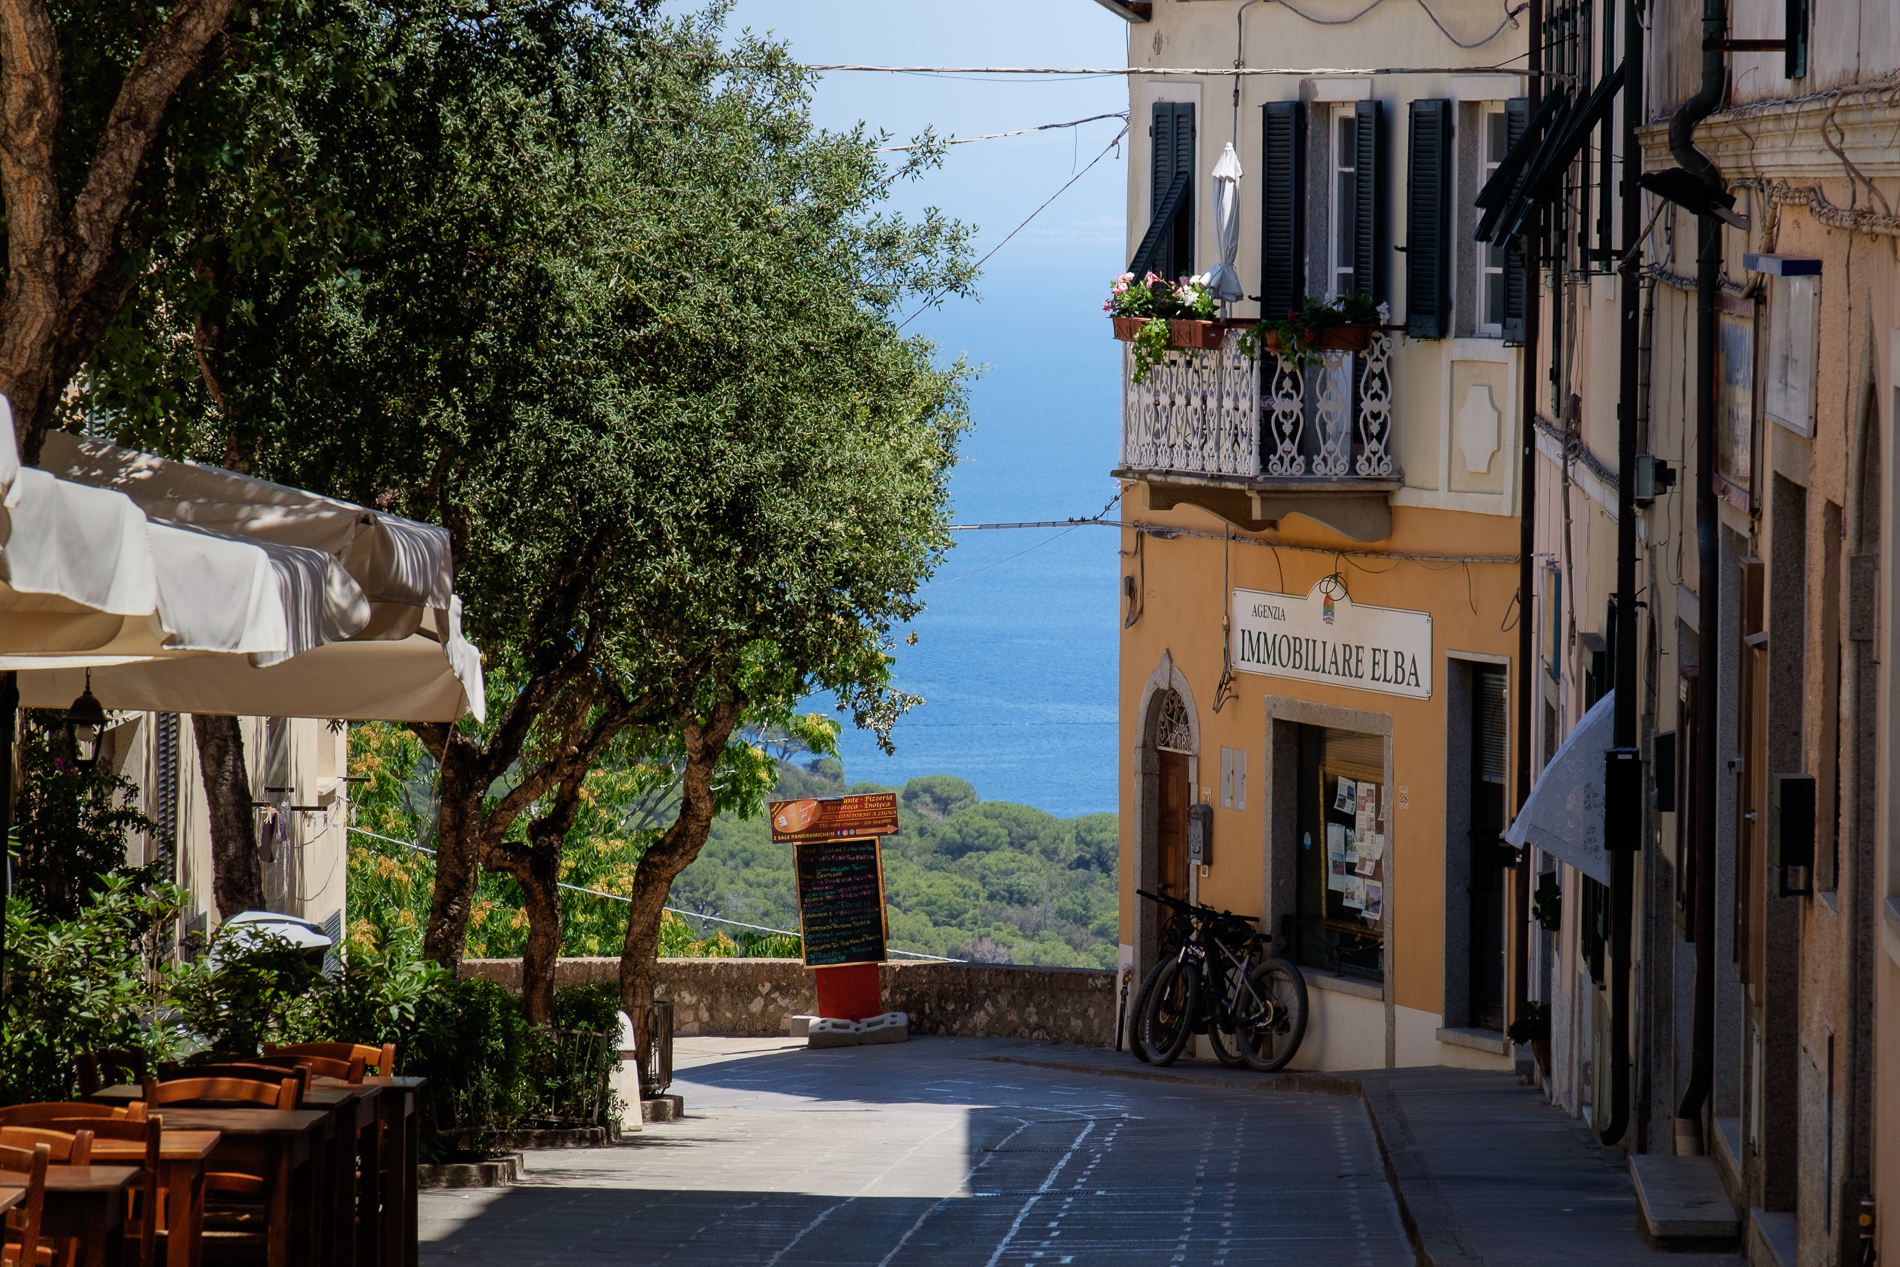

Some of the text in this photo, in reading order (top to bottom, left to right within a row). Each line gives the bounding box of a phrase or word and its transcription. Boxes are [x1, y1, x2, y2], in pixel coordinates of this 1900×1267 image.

[1251, 604, 1286, 621] AGENZIA
[1240, 629, 1421, 688] IMMOBILIARE ELBA
